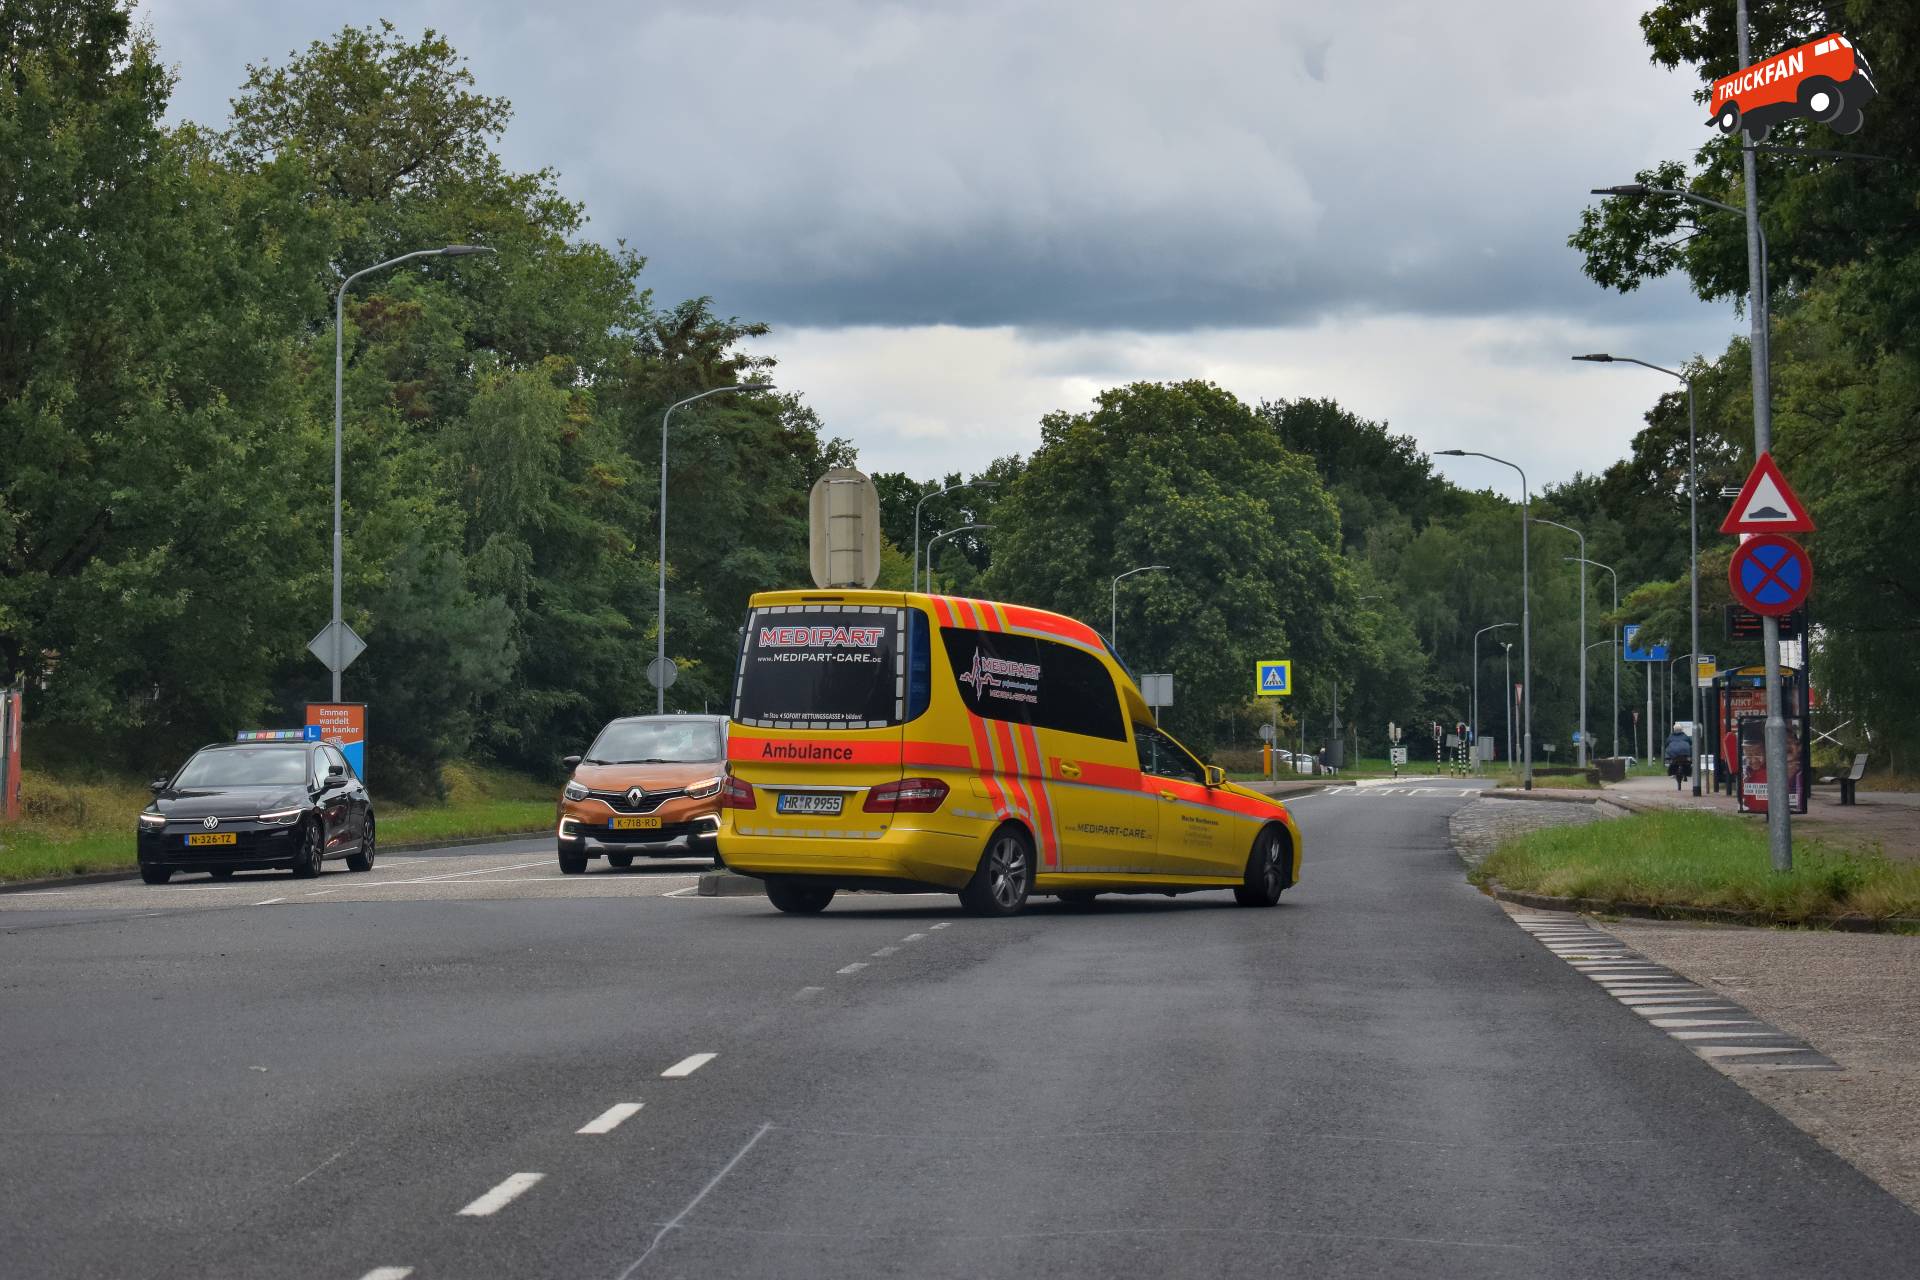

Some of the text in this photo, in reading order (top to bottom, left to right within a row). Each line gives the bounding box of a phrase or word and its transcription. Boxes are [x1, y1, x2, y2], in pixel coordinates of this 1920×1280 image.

[759, 626, 885, 648] MEDIPART
[981, 656, 1041, 681] MEDIPART
[319, 708, 349, 716] Emmen
[783, 712, 801, 720] SOFORT
[319, 717, 350, 725] wandelt
[308, 727, 316, 738] L
[332, 725, 359, 733] kanker
[762, 741, 853, 760] Ambulance
[783, 797, 840, 810] HR R 9955
[617, 818, 657, 828] K-718-RD
[191, 834, 231, 845] N-326-TZ
